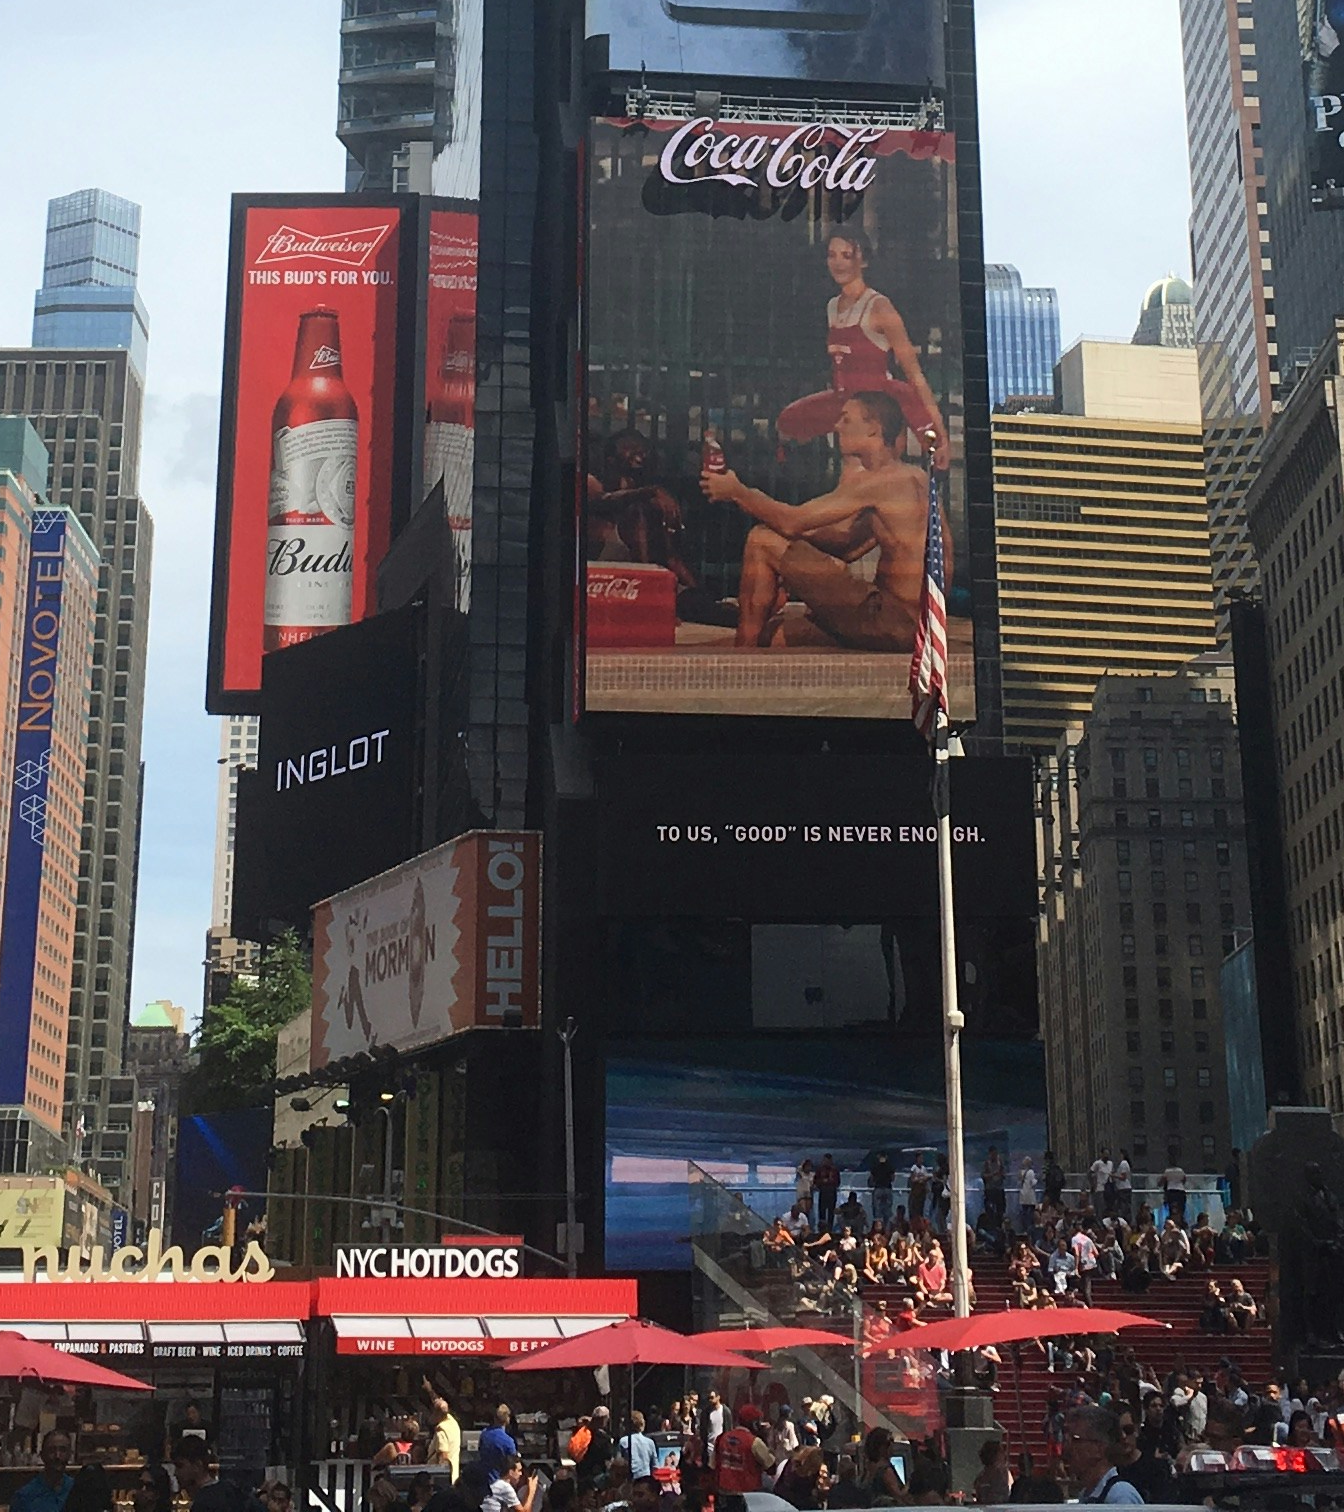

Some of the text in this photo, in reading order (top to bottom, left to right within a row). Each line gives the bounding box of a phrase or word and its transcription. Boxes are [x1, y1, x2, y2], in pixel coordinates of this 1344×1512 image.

[659, 117, 889, 192] Coca-Cola
[268, 234, 374, 254] Budweiser
[248, 271, 394, 284] THIS BUD'S FOR YOU.
[20, 533, 65, 732] NOVOTEL
[276, 730, 390, 791] INGLOT
[656, 825, 680, 842] TO
[687, 825, 719, 844] US,
[803, 825, 822, 842] IS
[828, 825, 893, 842] NEVER
[899, 825, 987, 842] ENOGH.
[485, 840, 525, 1016] HELLO!
[22, 1227, 276, 1284] nuchas
[336, 1248, 519, 1278] NYC HOTDOGS
[54, 1343, 99, 1355] EMPANADAS
[109, 1343, 145, 1355] PASTRIES
[153, 1345, 304, 1357] DRAFT BEER WINE ICED DRINKS COFFEE
[357, 1341, 395, 1351] WINE
[421, 1341, 485, 1351] HOTDOGS
